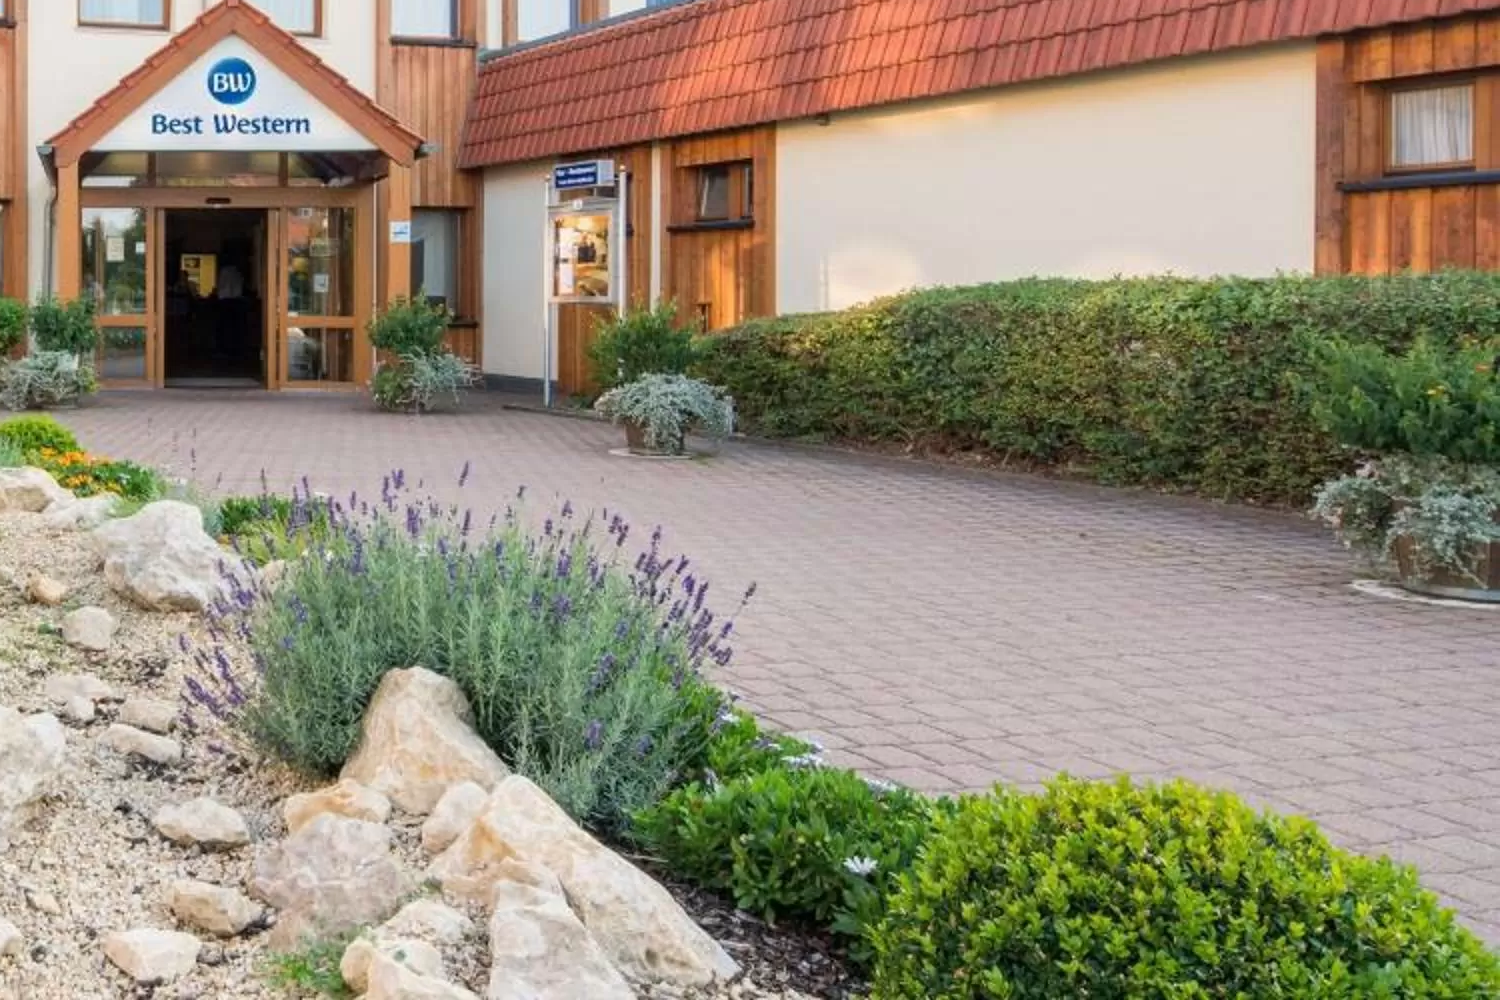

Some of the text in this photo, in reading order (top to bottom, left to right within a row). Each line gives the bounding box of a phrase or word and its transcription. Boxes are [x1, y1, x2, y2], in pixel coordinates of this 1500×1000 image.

[213, 72, 252, 94] BW
[151, 113, 311, 135] Best Western
